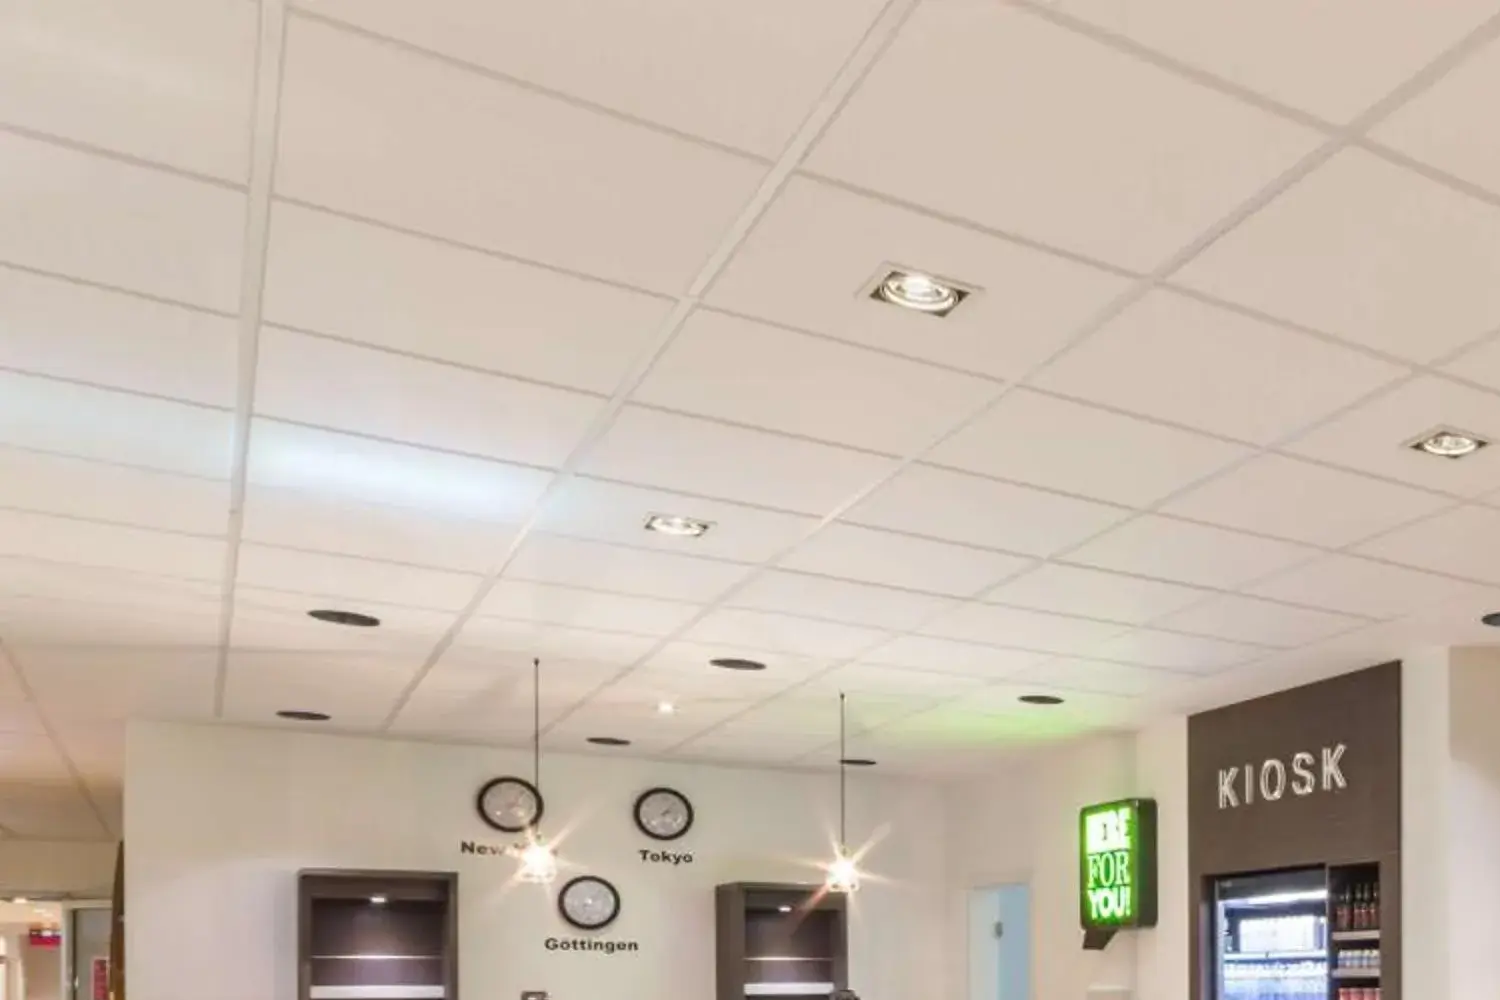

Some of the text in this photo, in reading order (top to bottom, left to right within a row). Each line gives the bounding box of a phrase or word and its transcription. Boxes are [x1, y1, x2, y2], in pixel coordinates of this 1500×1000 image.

[1218, 743, 1347, 809] KIOSK
[639, 849, 693, 864] Tokyo
[1088, 852, 1130, 888] FOR
[1088, 886, 1130, 918] YOU!
